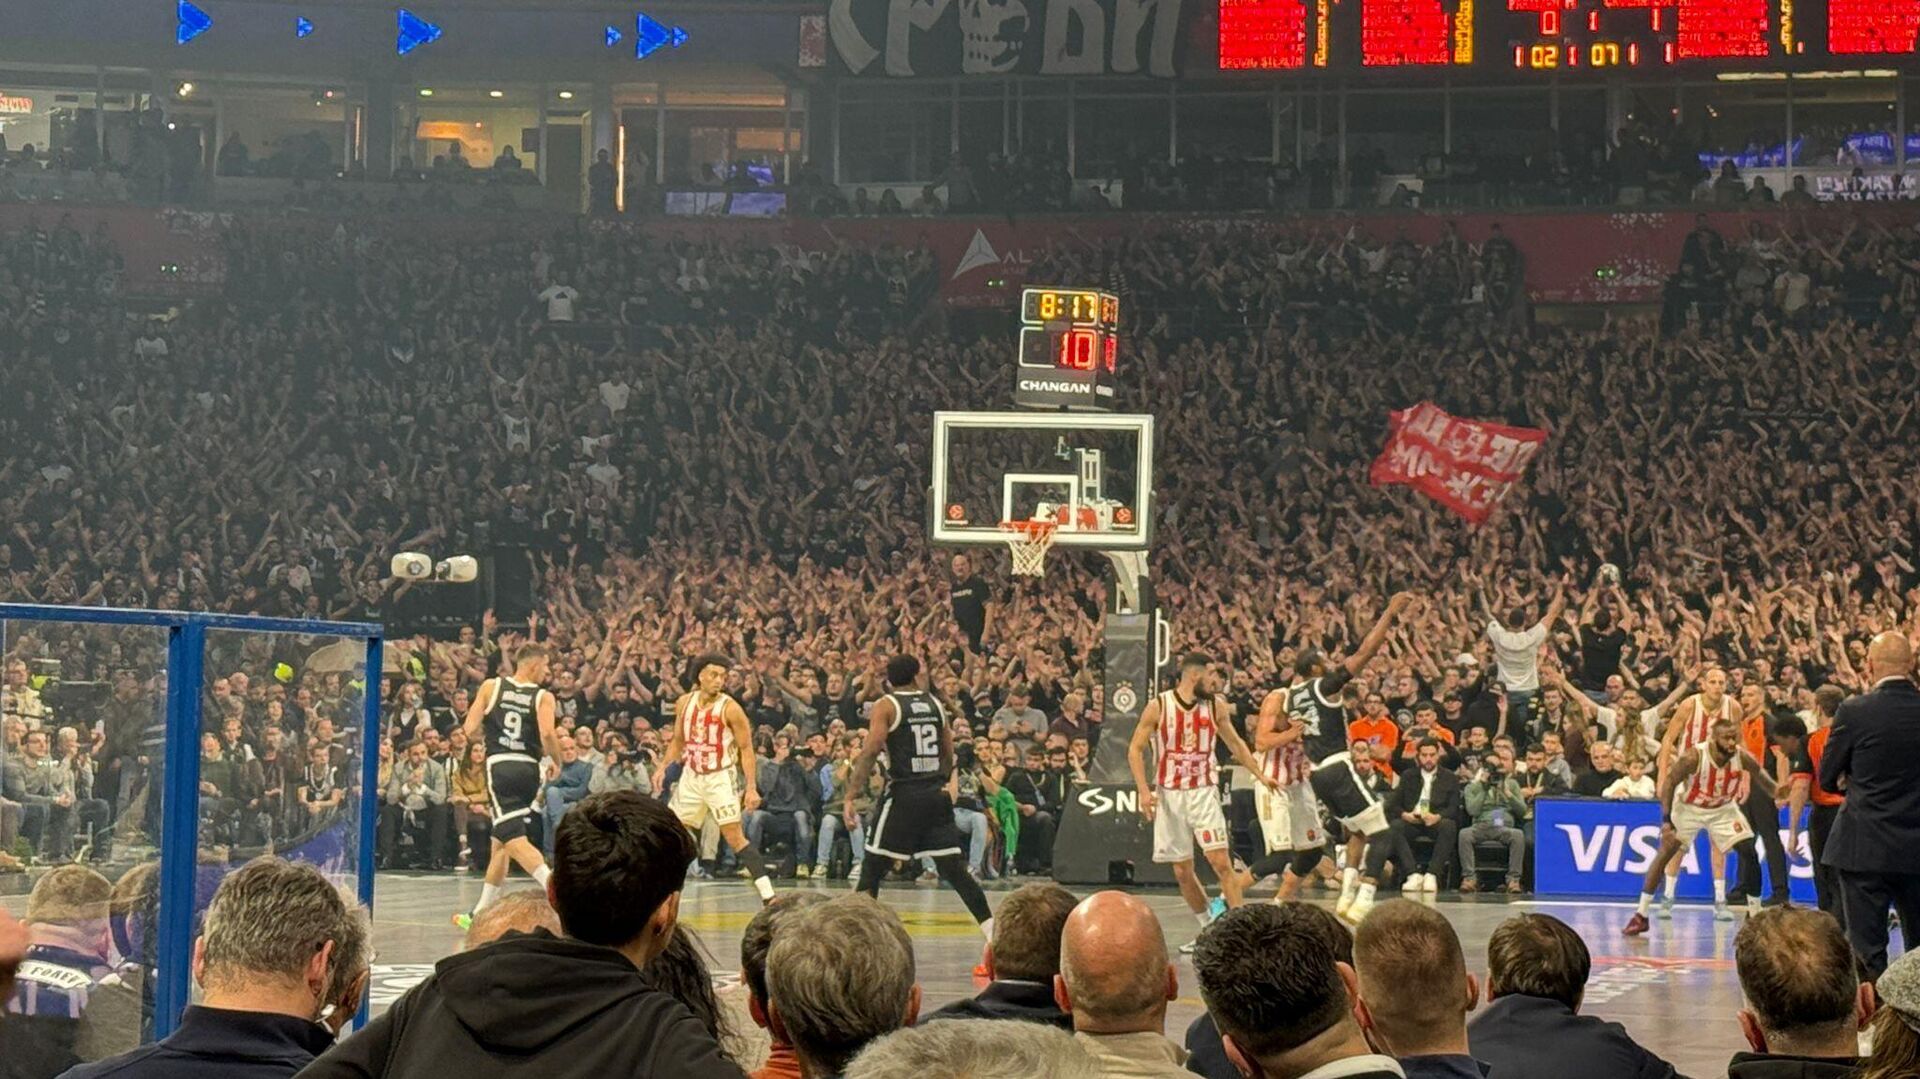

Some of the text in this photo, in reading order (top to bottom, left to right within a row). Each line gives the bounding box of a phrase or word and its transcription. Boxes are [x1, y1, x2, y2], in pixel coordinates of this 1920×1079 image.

[1542, 10, 1555, 34] 0
[1589, 11, 1598, 31] 1
[1531, 46, 1558, 67] 02
[1591, 43, 1619, 66] 07
[1041, 293, 1096, 320] 8:17
[1061, 332, 1095, 370] 10
[1019, 380, 1091, 394] CHANGAN
[503, 711, 522, 740] 9
[911, 723, 939, 756] 12
